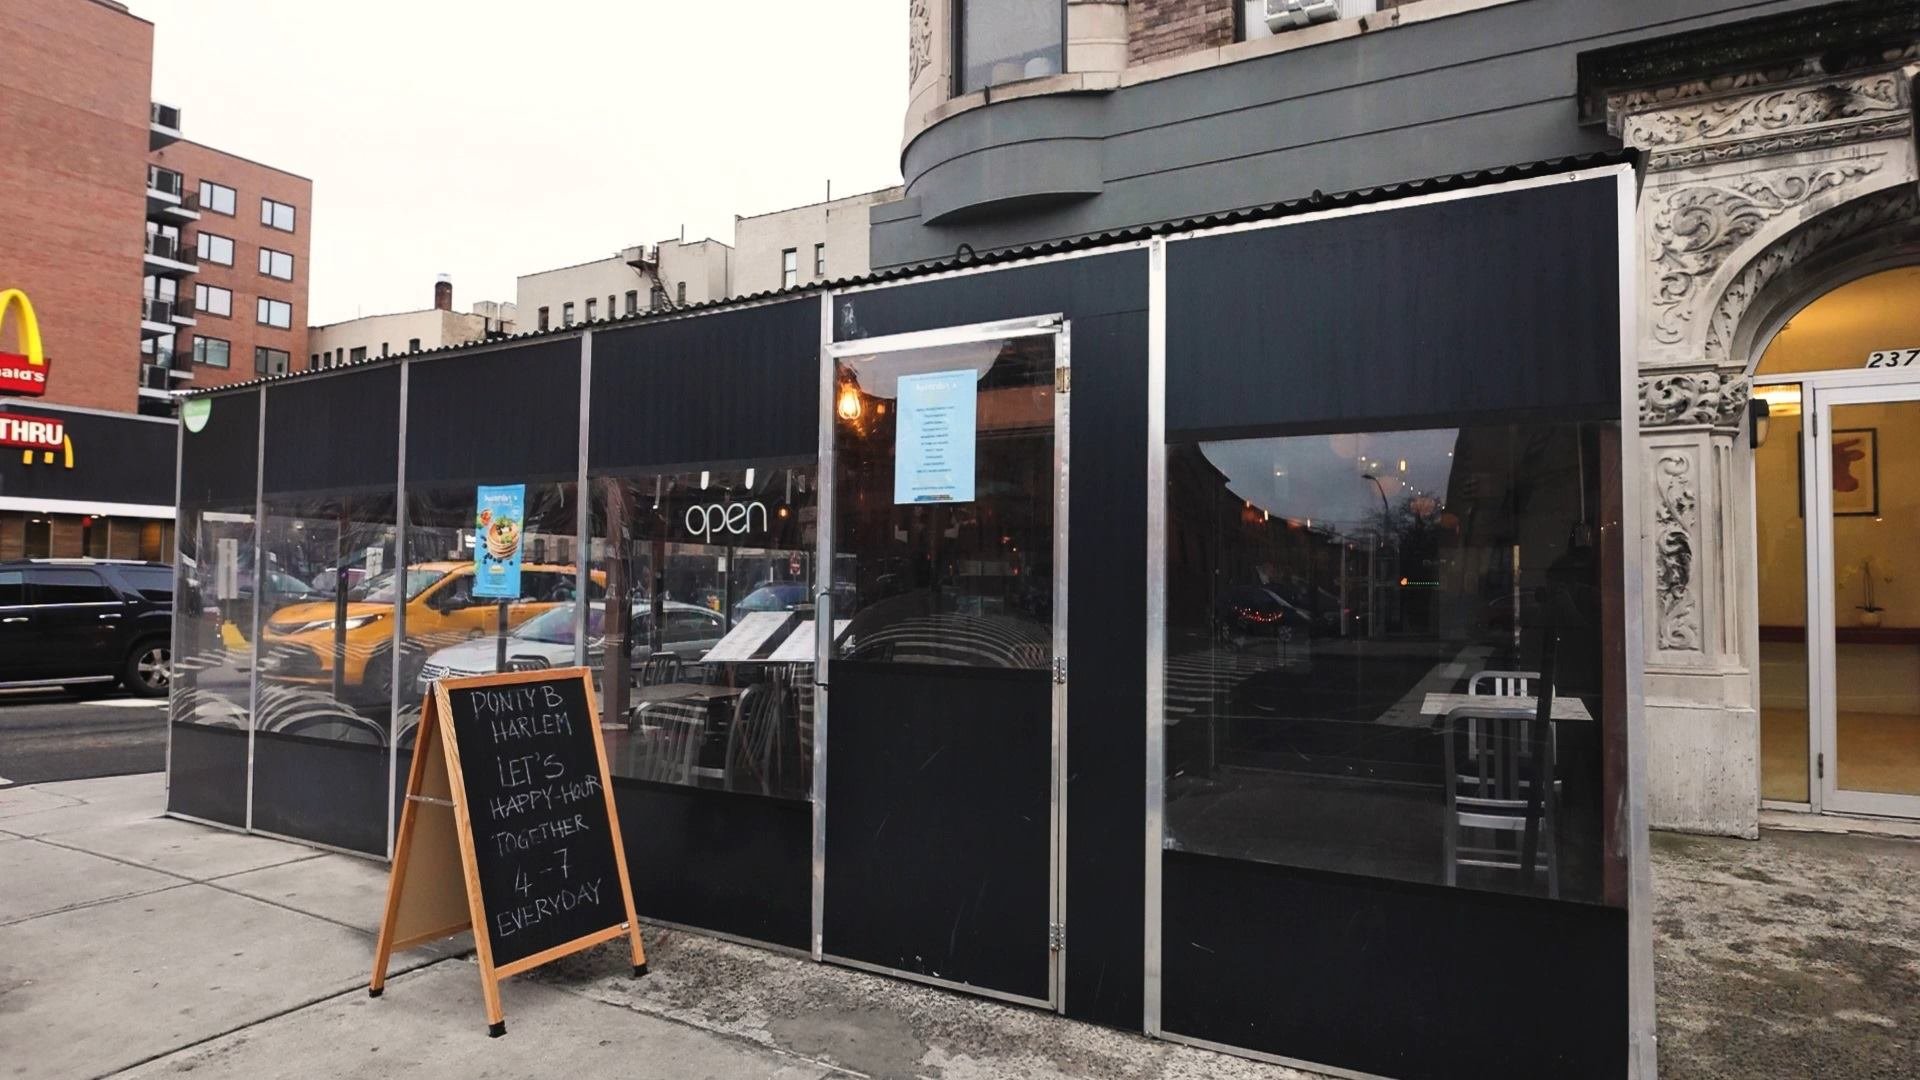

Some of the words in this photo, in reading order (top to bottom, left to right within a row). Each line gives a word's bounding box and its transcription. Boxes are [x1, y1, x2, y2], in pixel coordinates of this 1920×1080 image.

[0, 368, 45, 382] ald's
[1868, 349, 1920, 368] 237
[0, 418, 63, 445] THRU
[685, 502, 767, 543] open
[541, 685, 563, 707] B
[491, 712, 572, 743] HARLEM
[497, 752, 565, 787] LET'S
[491, 814, 589, 856] TOGETHER
[514, 864, 533, 897] 4
[553, 848, 572, 879] 7
[496, 878, 602, 937] EVERYDAY
